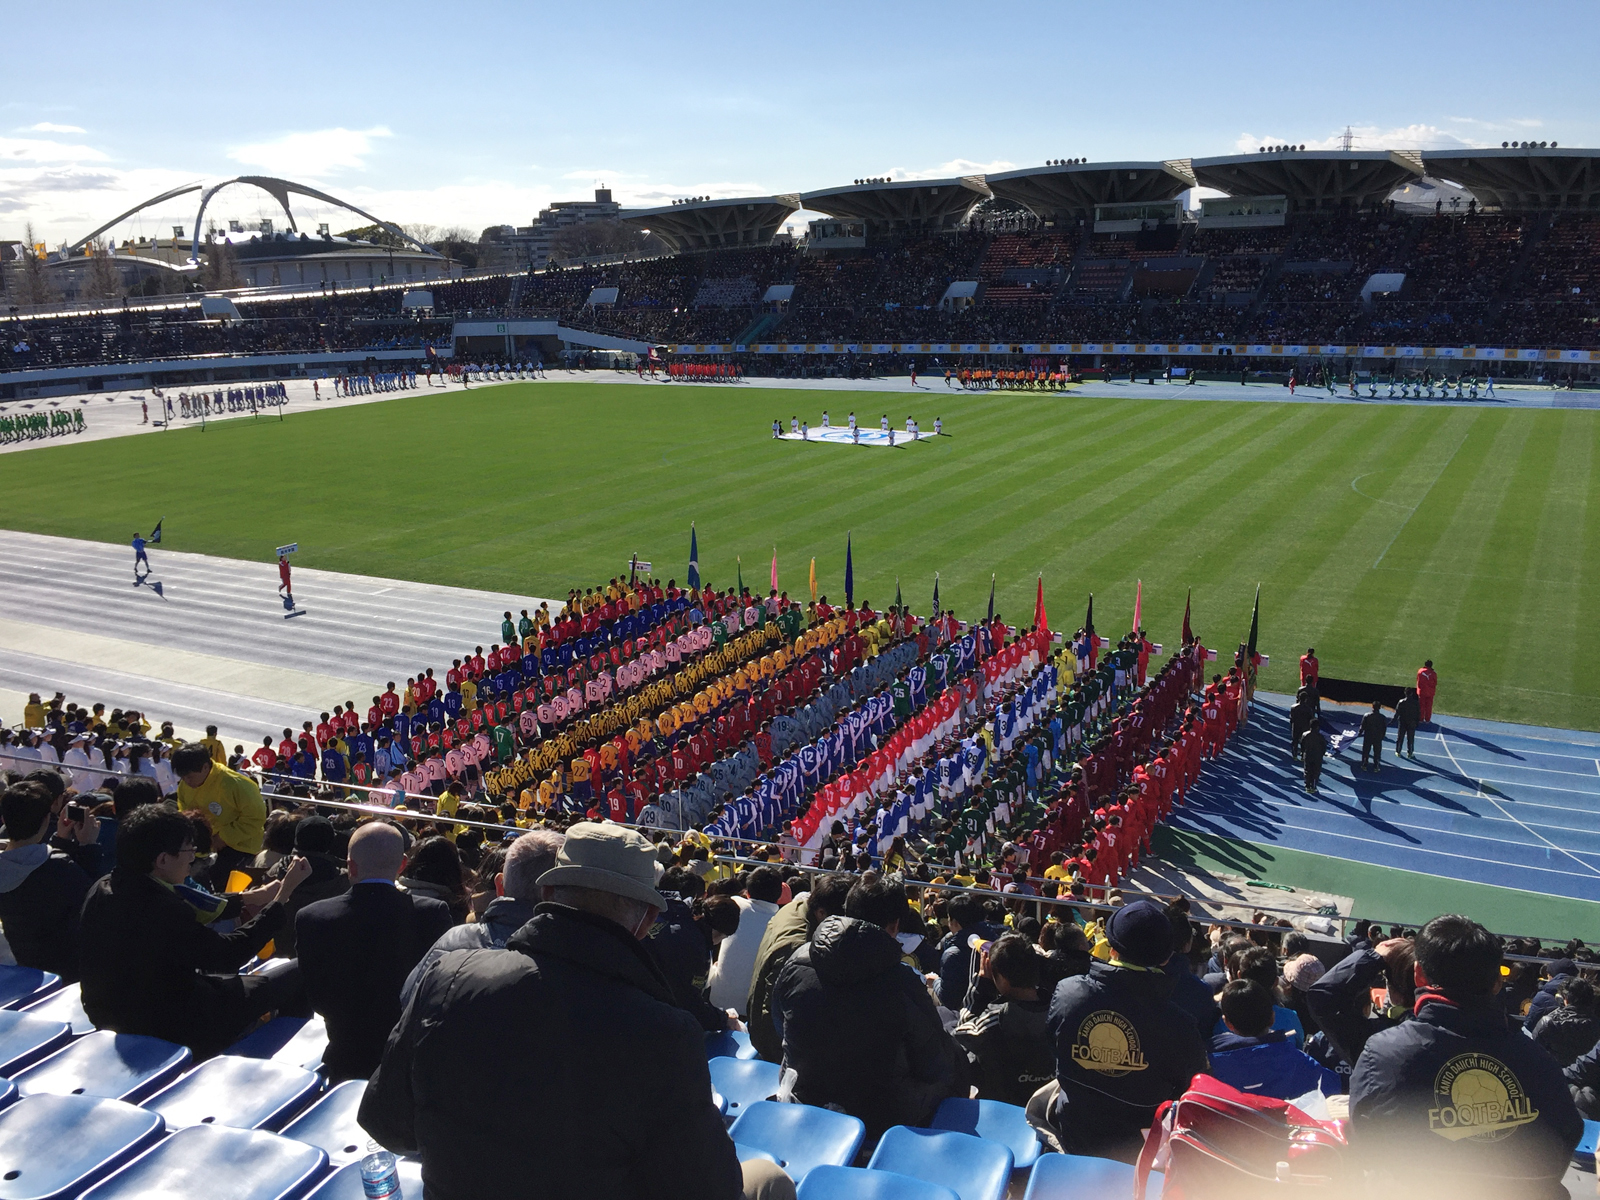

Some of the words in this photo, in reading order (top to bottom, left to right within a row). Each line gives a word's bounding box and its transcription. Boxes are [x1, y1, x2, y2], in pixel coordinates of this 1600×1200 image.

[714, 626, 721, 635] 25
[965, 640, 969, 648] 5
[668, 648, 674, 656] 21
[544, 655, 551, 663] 12
[525, 661, 532, 670] 13
[933, 661, 942, 670] 30
[913, 671, 921, 680] 21
[463, 688, 469, 698] 17
[589, 687, 596, 696] 15
[894, 688, 904, 698] 25
[384, 698, 393, 707] 22
[448, 699, 455, 708] 18
[554, 702, 562, 711] 28
[543, 710, 548, 720] 5
[1205, 709, 1217, 719] 10
[522, 717, 532, 727] 20
[778, 721, 786, 731] 19
[496, 732, 504, 742] 17
[692, 743, 699, 754] 18
[605, 751, 609, 760] 2
[804, 751, 813, 762] 12
[969, 753, 978, 764] 29
[674, 758, 683, 769] 10
[574, 766, 585, 776] 22
[714, 769, 723, 780] 25
[940, 766, 950, 777] 15
[404, 778, 412, 789] 11
[840, 780, 850, 791] 18
[609, 798, 619, 810] 19
[661, 801, 670, 812] 30
[739, 803, 748, 815] 11
[645, 811, 655, 823] 29
[967, 818, 977, 831] 21
[791, 827, 803, 839] 29
[1072, 1044, 1147, 1067] FOOTBALL
[1440, 1072, 1454, 1096] KANTO
[1450, 1058, 1478, 1072] DAIICHI
[1480, 1059, 1500, 1074] HIGH
[1499, 1070, 1519, 1099] SCHOOL
[1428, 1097, 1536, 1128] FOOTBALL
